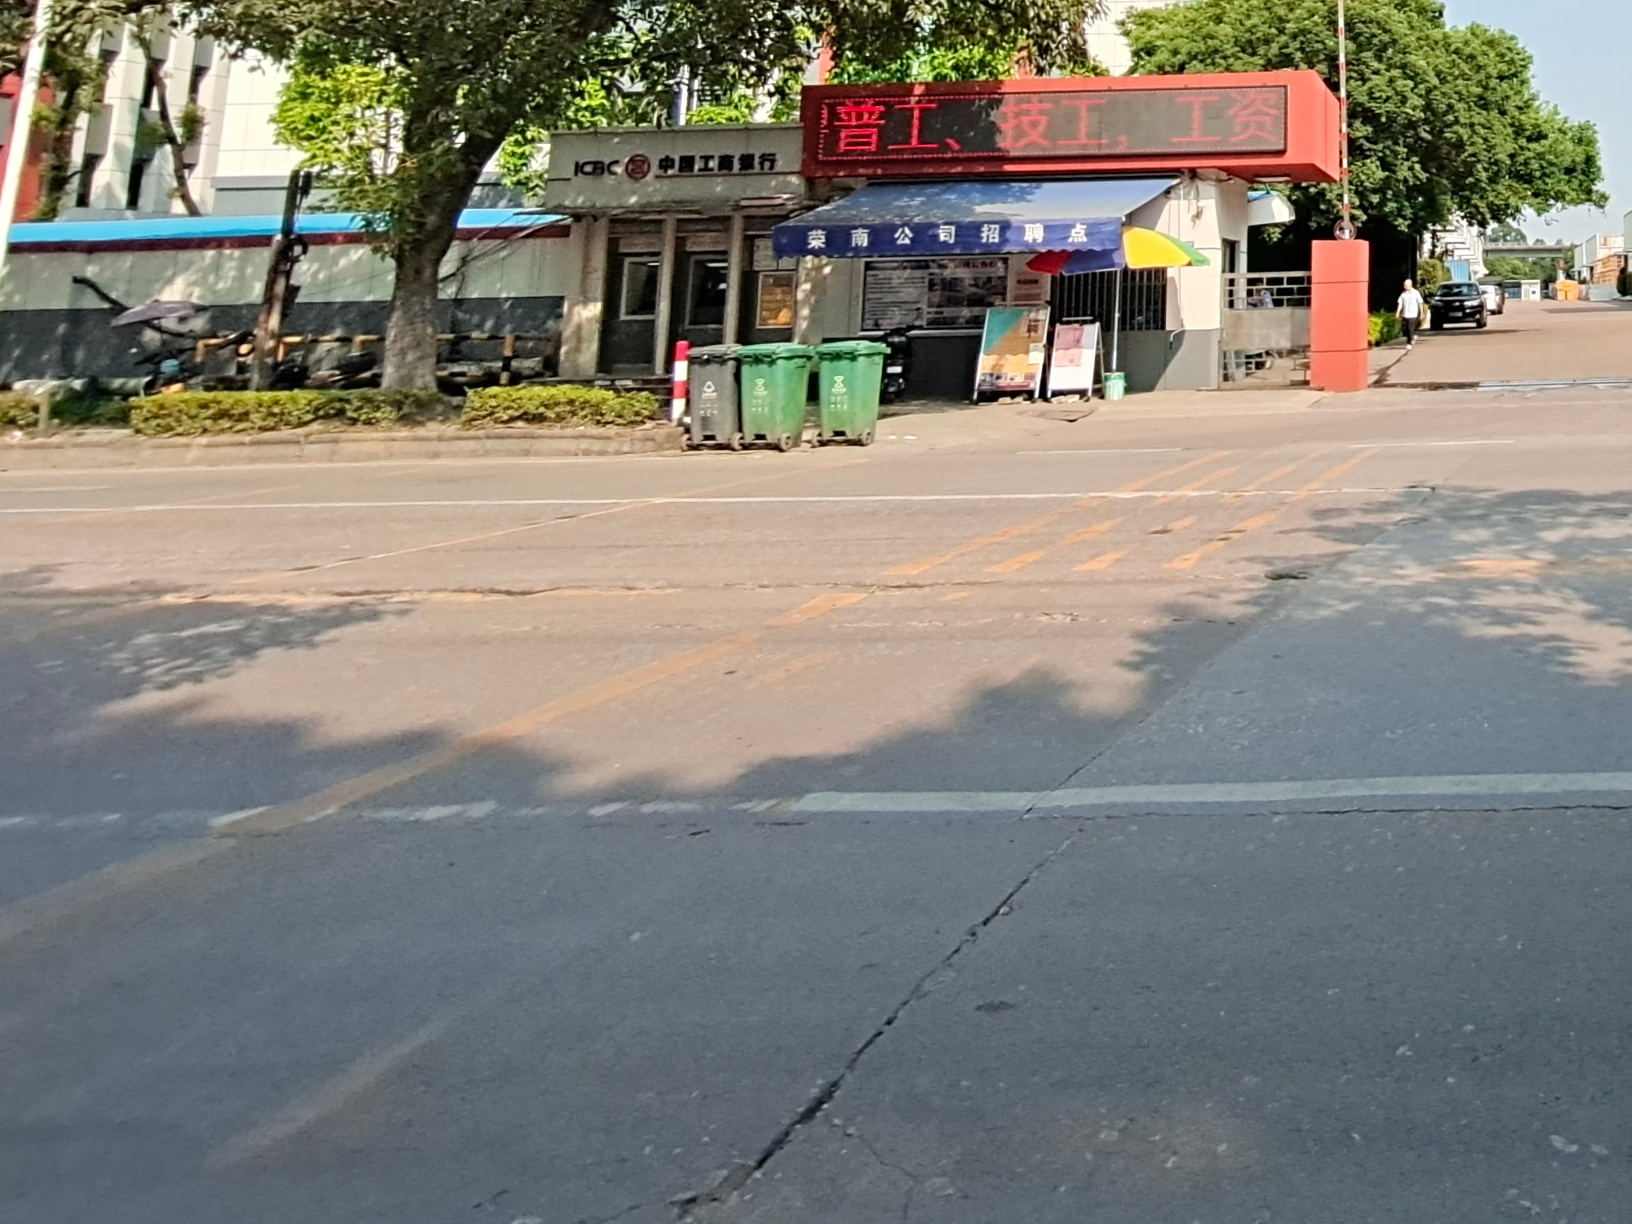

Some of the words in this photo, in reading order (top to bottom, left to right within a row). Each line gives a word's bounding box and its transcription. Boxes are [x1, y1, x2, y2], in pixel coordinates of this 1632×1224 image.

[821, 88, 1281, 152] 普工、技工，工资
[573, 160, 620, 176] ICBC
[658, 153, 777, 174] 中国工商银行
[807, 223, 1088, 250] 荣南公司招聘点
